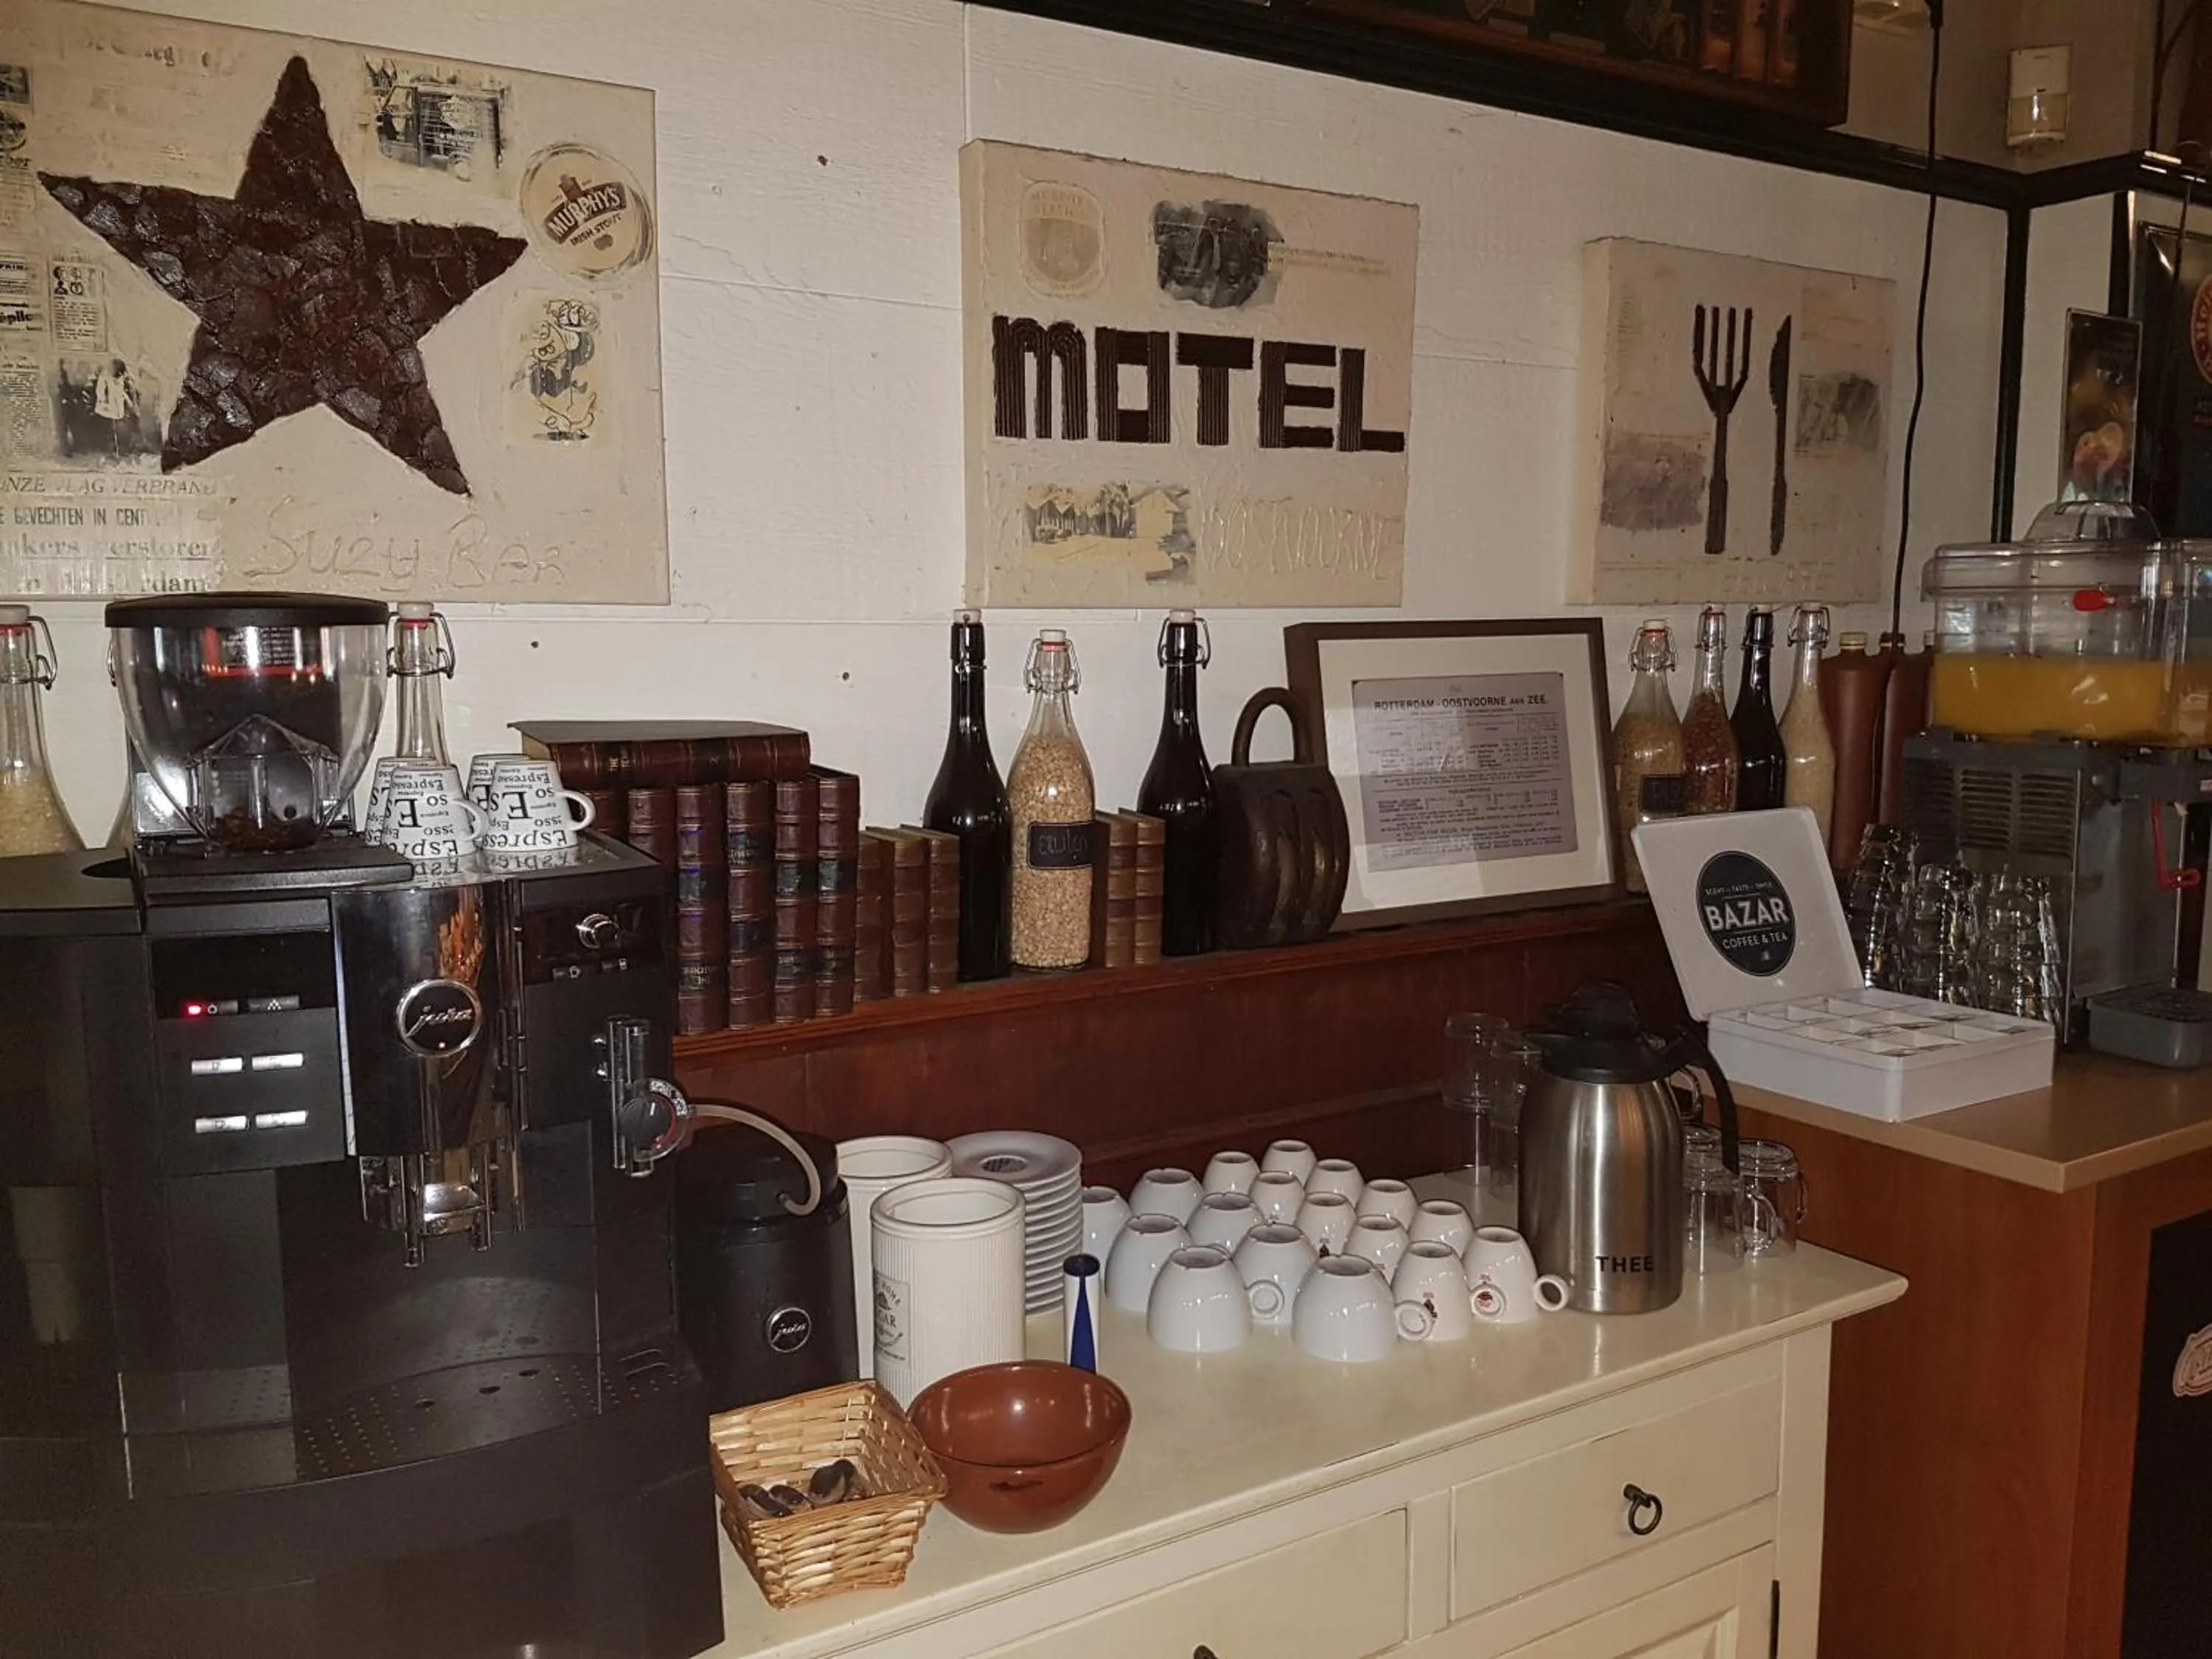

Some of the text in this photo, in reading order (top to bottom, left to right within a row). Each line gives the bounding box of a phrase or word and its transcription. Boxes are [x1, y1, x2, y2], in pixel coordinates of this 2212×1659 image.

[570, 228, 593, 246] IRISH
[992, 313, 1405, 453] MOTEL
[14, 507, 83, 526] GEVECHTEN
[93, 508, 106, 526] IN
[1528, 694, 1547, 705] ZEE
[1705, 897, 1790, 931] BAZAR
[1722, 931, 1788, 949] COFFEE & TEA
[1595, 1256, 1653, 1273] THEE
